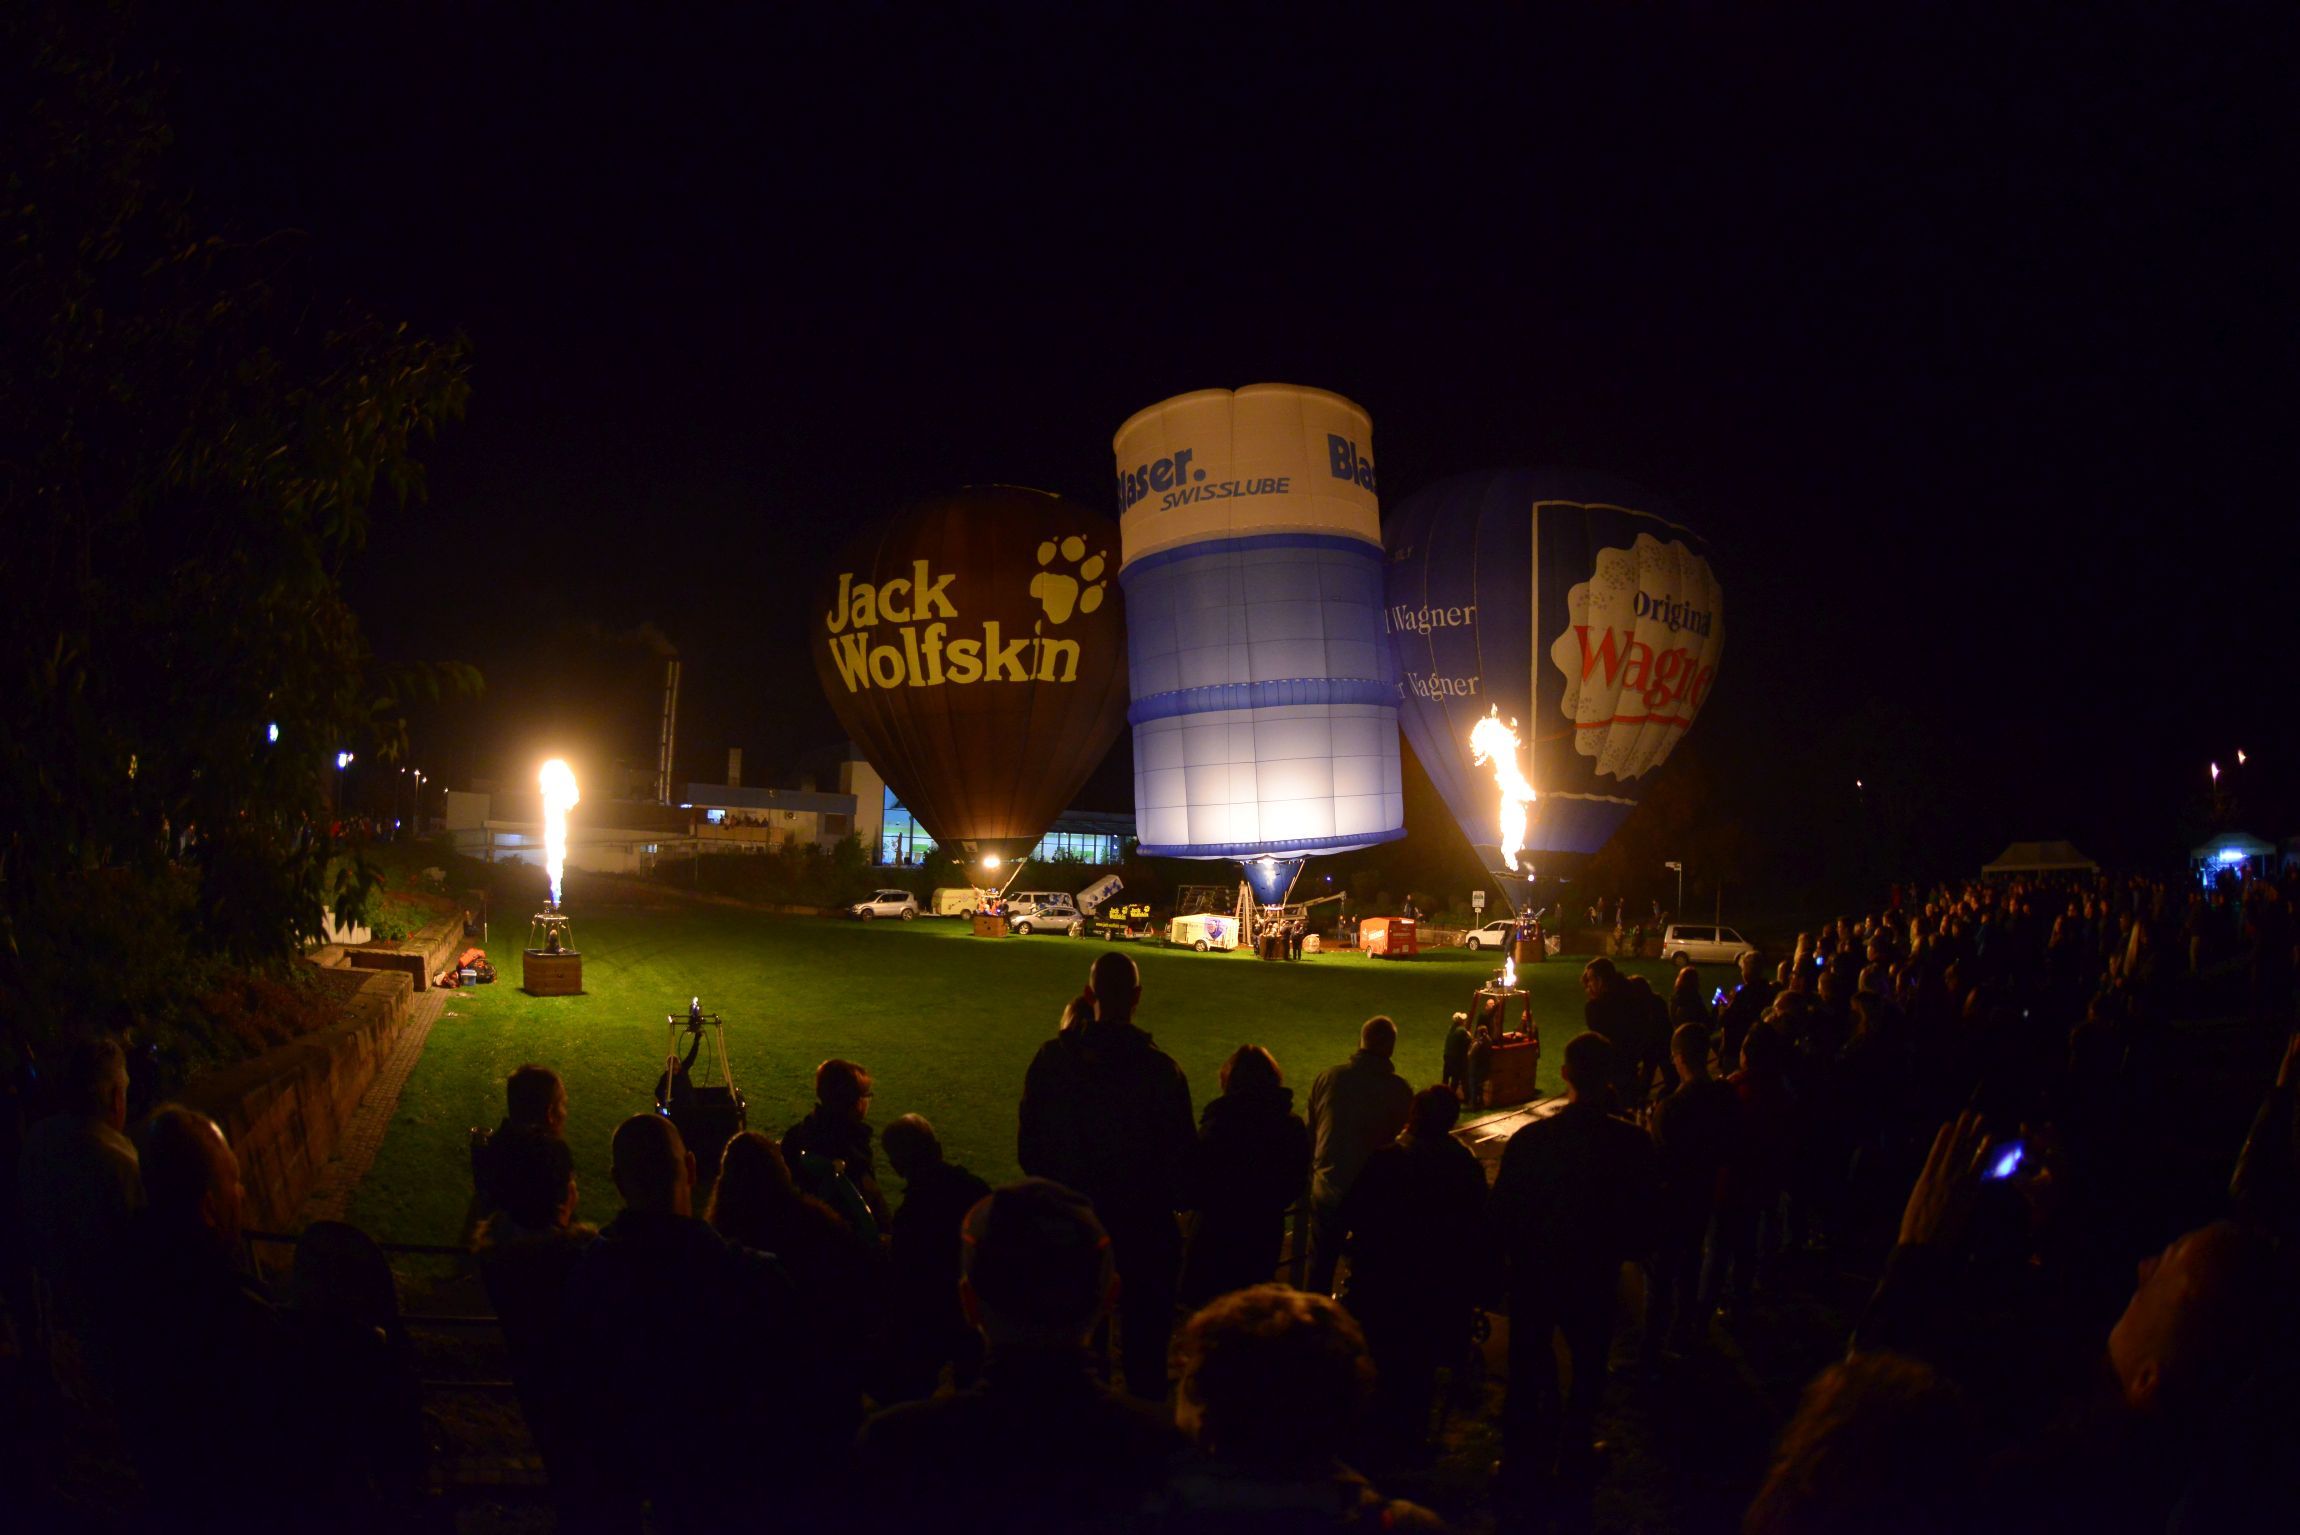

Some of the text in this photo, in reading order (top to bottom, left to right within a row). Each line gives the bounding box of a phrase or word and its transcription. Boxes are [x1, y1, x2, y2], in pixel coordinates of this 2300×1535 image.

[1160, 478, 1290, 511] SWISSLUBE
[826, 560, 958, 633] Jack
[1392, 604, 1476, 635] Wagner
[829, 619, 1080, 693] Wolfskin
